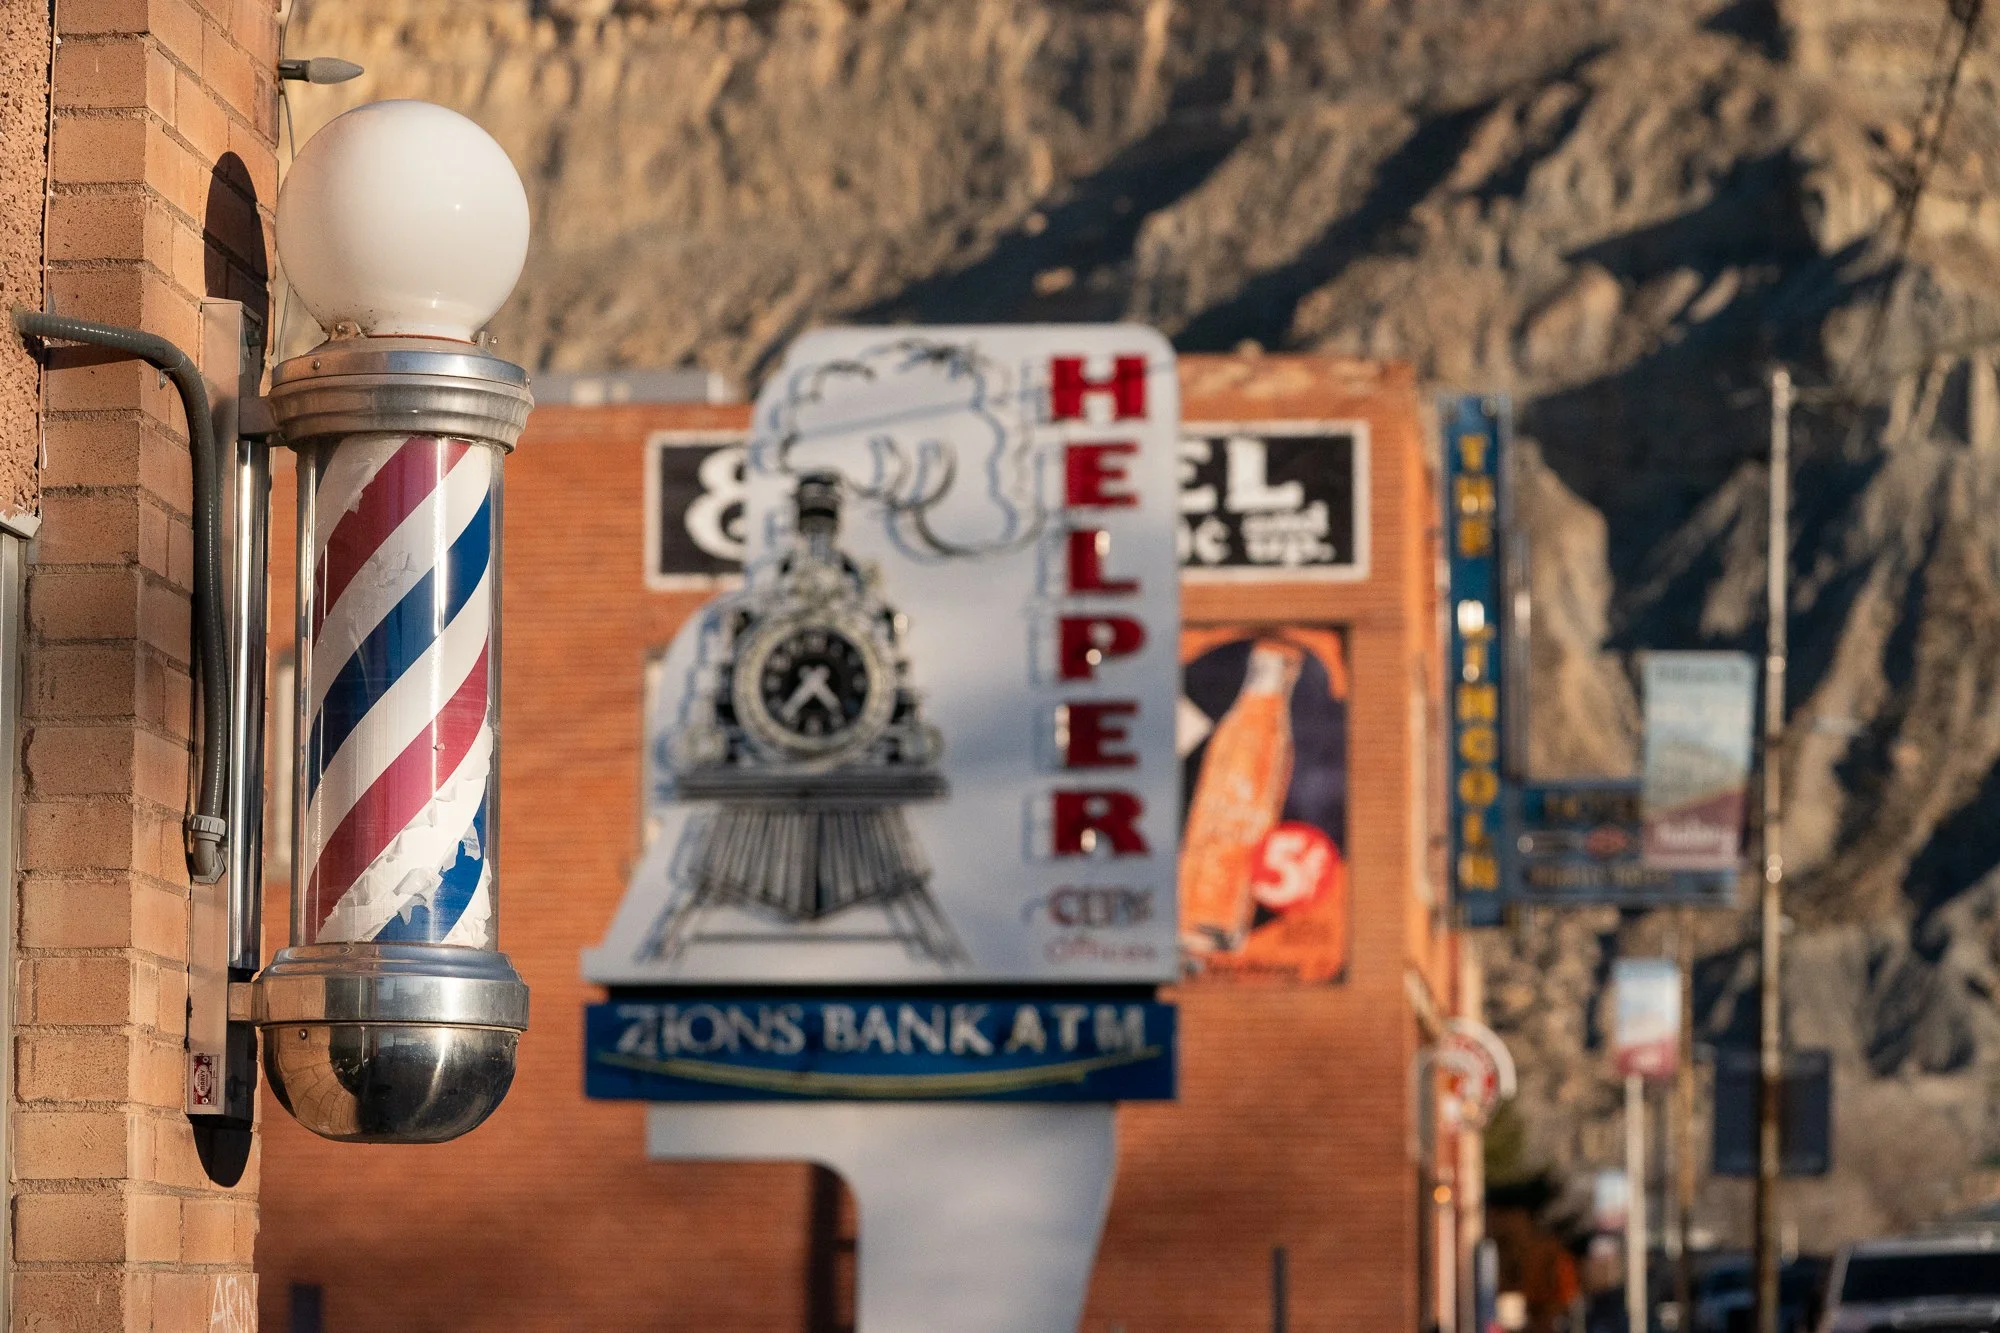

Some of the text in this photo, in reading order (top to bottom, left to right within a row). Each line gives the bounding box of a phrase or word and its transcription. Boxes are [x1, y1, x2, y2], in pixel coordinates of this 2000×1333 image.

[1049, 354, 1150, 859] HELPER
[616, 1004, 1147, 1056] ZIONS BANK ATM
